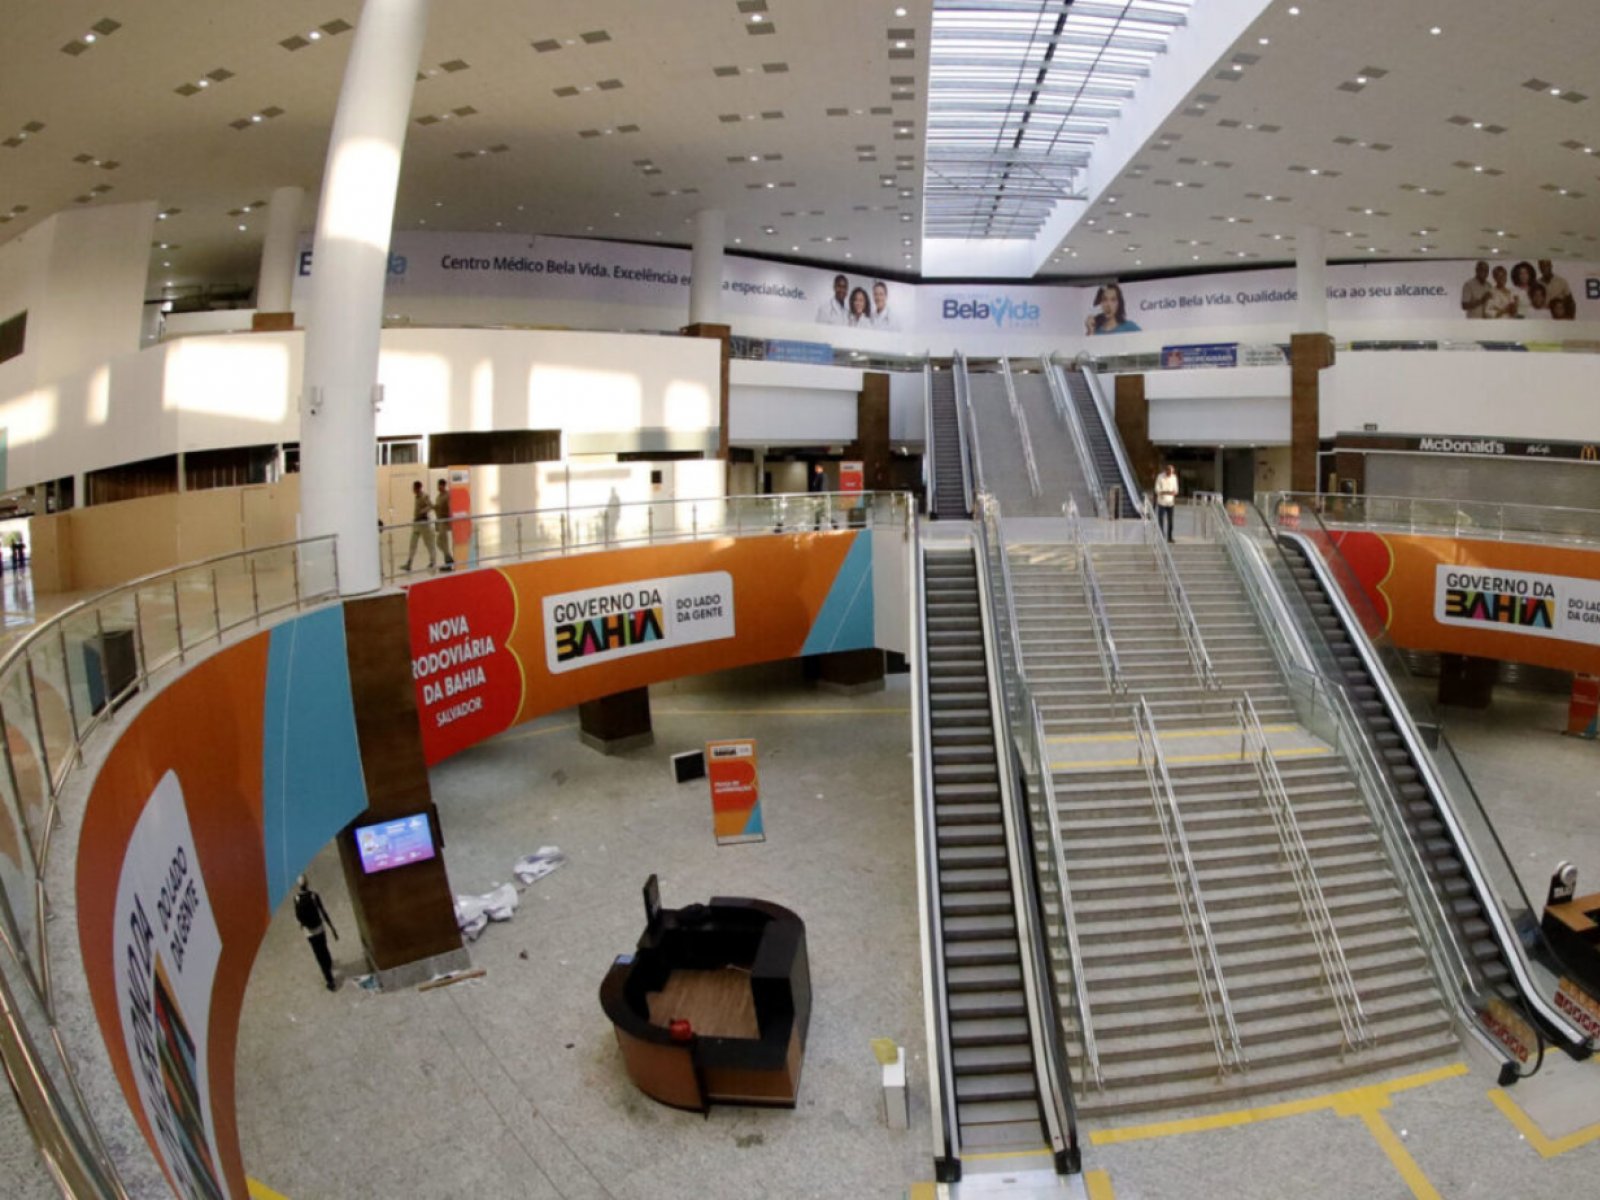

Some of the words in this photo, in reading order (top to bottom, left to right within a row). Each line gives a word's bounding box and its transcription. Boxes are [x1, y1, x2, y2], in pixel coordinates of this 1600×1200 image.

[441, 255, 490, 270] Centro
[493, 255, 543, 273] Médico
[547, 260, 575, 275] Bela
[579, 262, 610, 278] Vida.
[614, 265, 678, 285] Excelência
[732, 281, 807, 300] especialidade.
[1140, 298, 1177, 311] Cartão
[1179, 294, 1204, 307] Bela
[1206, 292, 1234, 305] Vida.
[1236, 289, 1298, 304] Qualidade
[1350, 287, 1365, 298] ao
[1368, 286, 1391, 298] seu
[1394, 284, 1447, 297] alcance.
[1418, 437, 1505, 455] McDonald's
[1446, 573, 1528, 595] GOVERNO
[1533, 581, 1555, 598] DA
[553, 592, 635, 623] GOVERNO
[639, 588, 662, 608] DA
[676, 598, 692, 610] DO
[693, 594, 721, 607] LADO
[677, 611, 691, 622] DA
[692, 606, 723, 620] GENTE
[1445, 589, 1555, 630] BAHIA
[1567, 610, 1580, 621] DA
[1568, 598, 1584, 610] DO
[428, 615, 469, 644] NOVA
[555, 607, 664, 662] BAHIA
[423, 681, 444, 706] DA
[444, 666, 487, 697] BAHIA
[436, 696, 483, 728] SALVADOR
